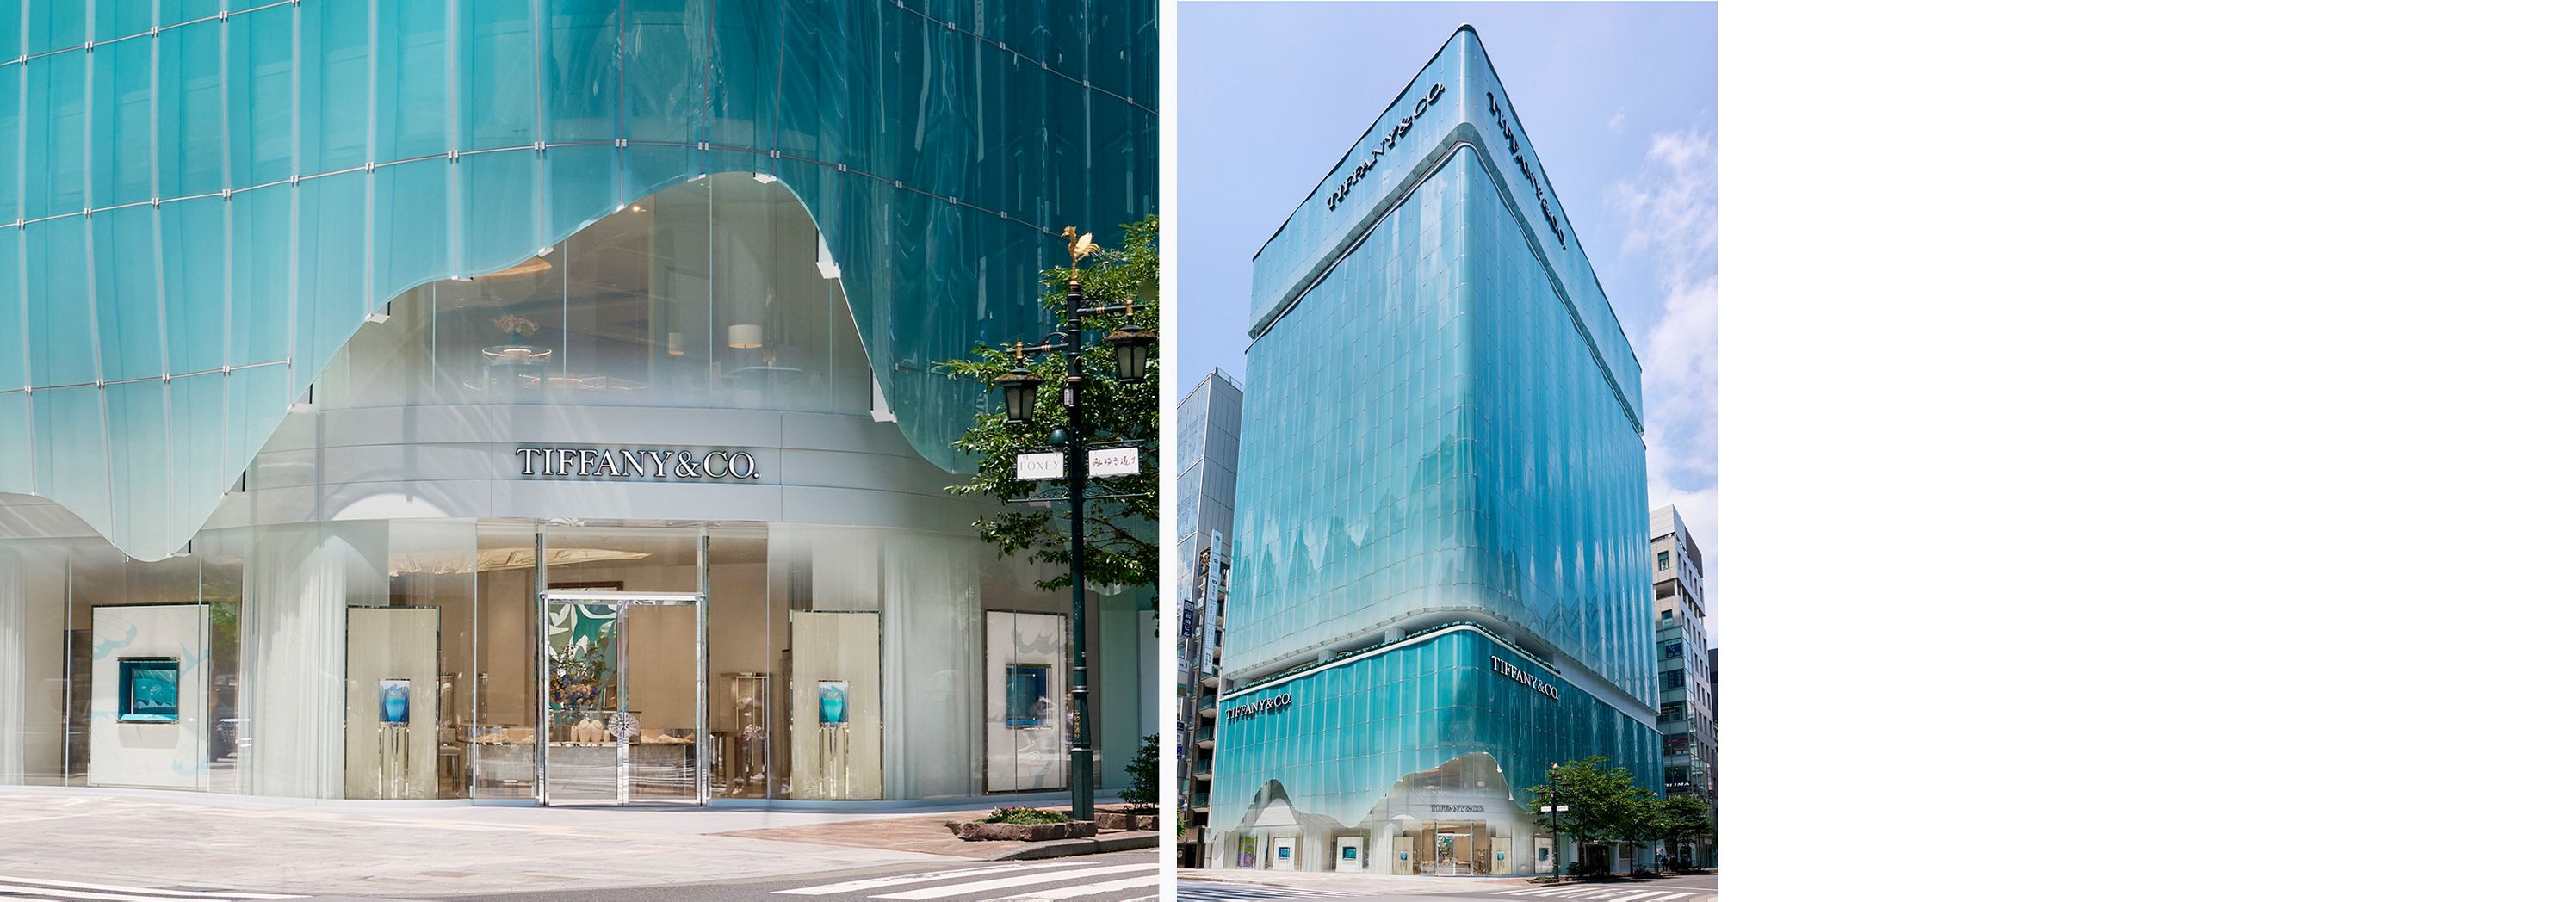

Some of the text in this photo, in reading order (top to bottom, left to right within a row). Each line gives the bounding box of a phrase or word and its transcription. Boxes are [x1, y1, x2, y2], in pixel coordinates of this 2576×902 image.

[516, 448, 760, 479] TIFFANY&CO.
[1020, 460, 1060, 471] FOXEY
[1491, 655, 1559, 700] TIFFANY&CO.
[1225, 693, 1291, 720] TIFFANY&CO.
